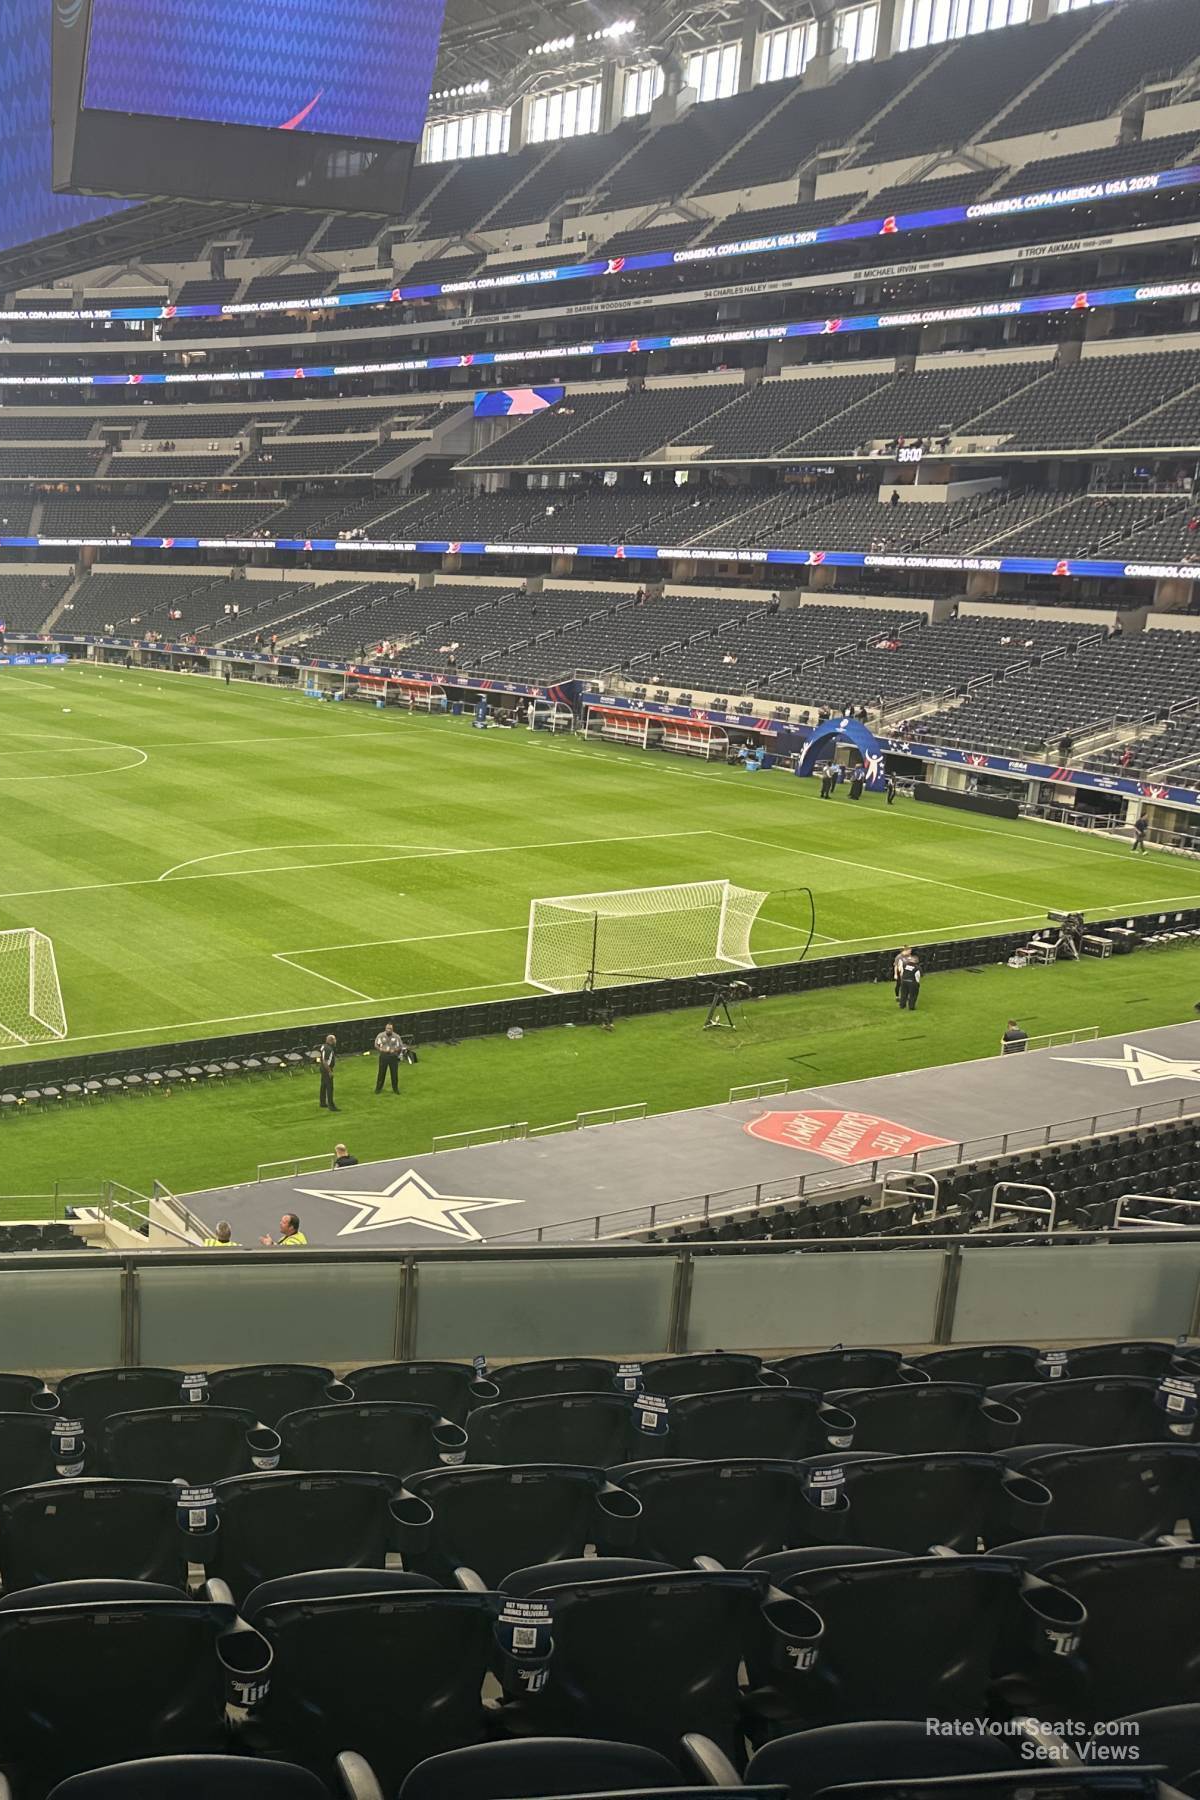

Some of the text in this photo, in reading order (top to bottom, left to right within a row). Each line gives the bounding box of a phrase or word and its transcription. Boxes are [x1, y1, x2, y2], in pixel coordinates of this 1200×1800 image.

[967, 174, 1160, 218] CONMEBOL COPA AMERICA USA 2024
[674, 231, 816, 262] CONMEBOL COPA AMERICA USA 2024
[1025, 246, 1046, 256] TROY
[1048, 241, 1080, 254] AIKMAN
[863, 267, 896, 278] MICHAEL
[713, 286, 744, 297] CHARLES
[744, 284, 767, 293] HALEY
[782, 1112, 826, 1145] ARMY
[818, 1112, 879, 1160] SALVATION
[872, 1130, 912, 1154] THE
